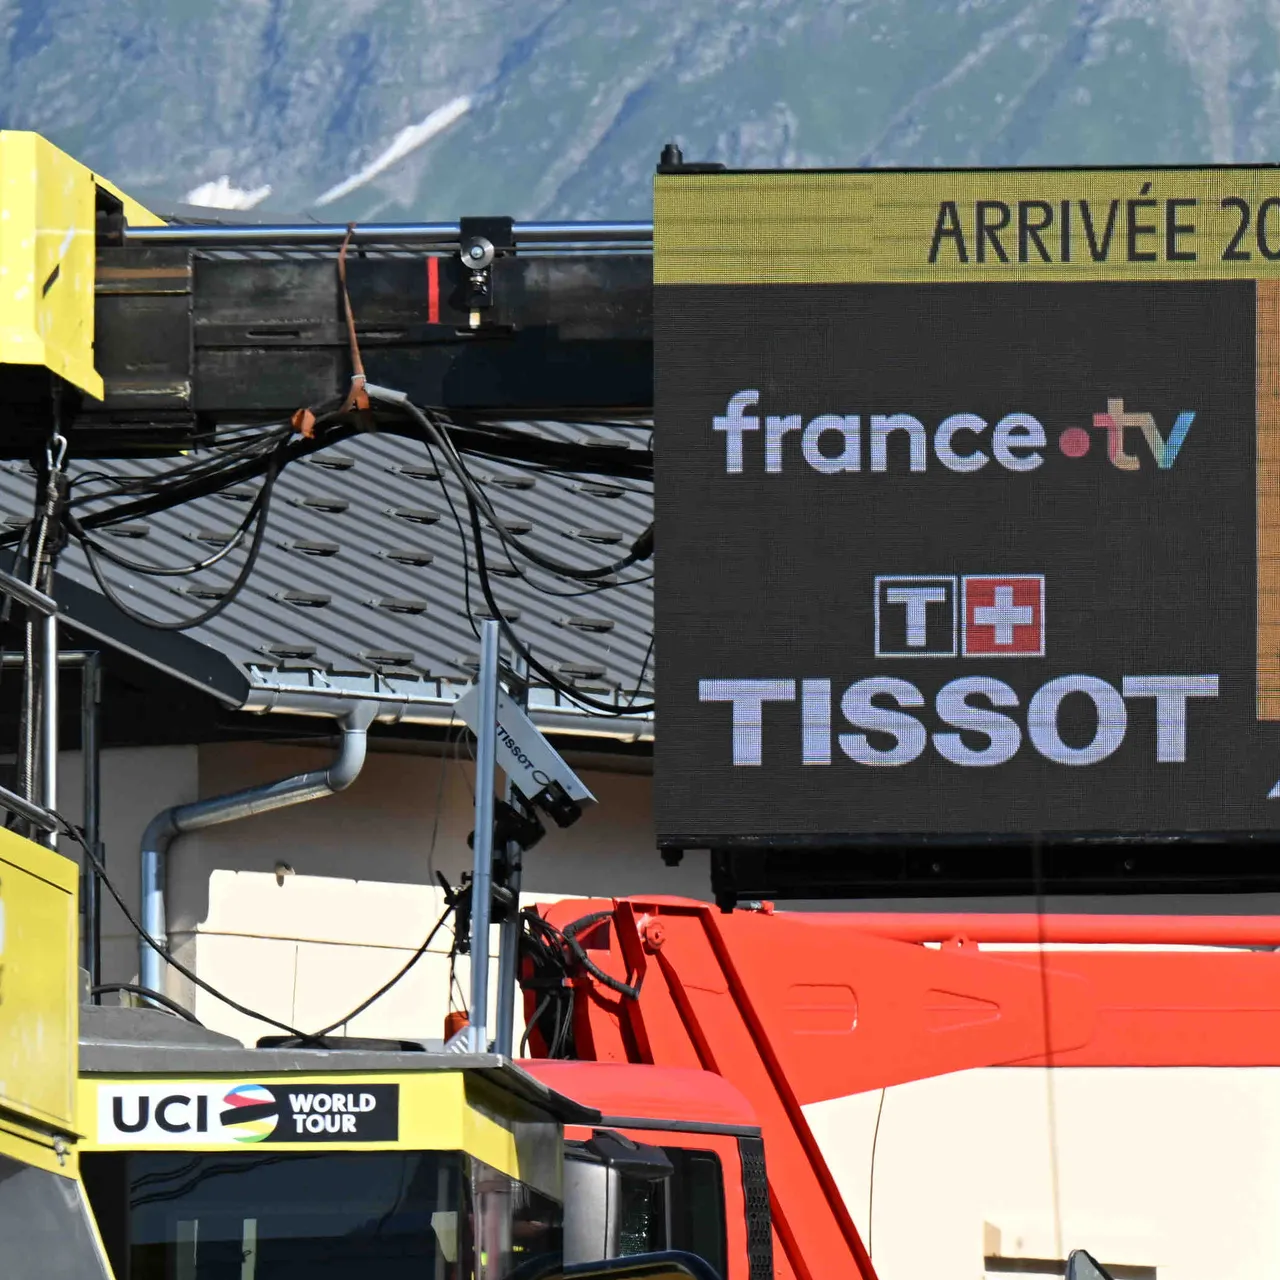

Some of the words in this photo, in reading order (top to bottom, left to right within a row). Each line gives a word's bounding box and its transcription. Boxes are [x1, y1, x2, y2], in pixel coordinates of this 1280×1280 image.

[928, 182, 1198, 263] ARRIVÉE
[699, 675, 1218, 766] TISSOT
[496, 725, 535, 770] TISSOT
[112, 1094, 209, 1133] UCI
[289, 1093, 376, 1113] WORLD
[292, 1113, 358, 1134] TOUR
